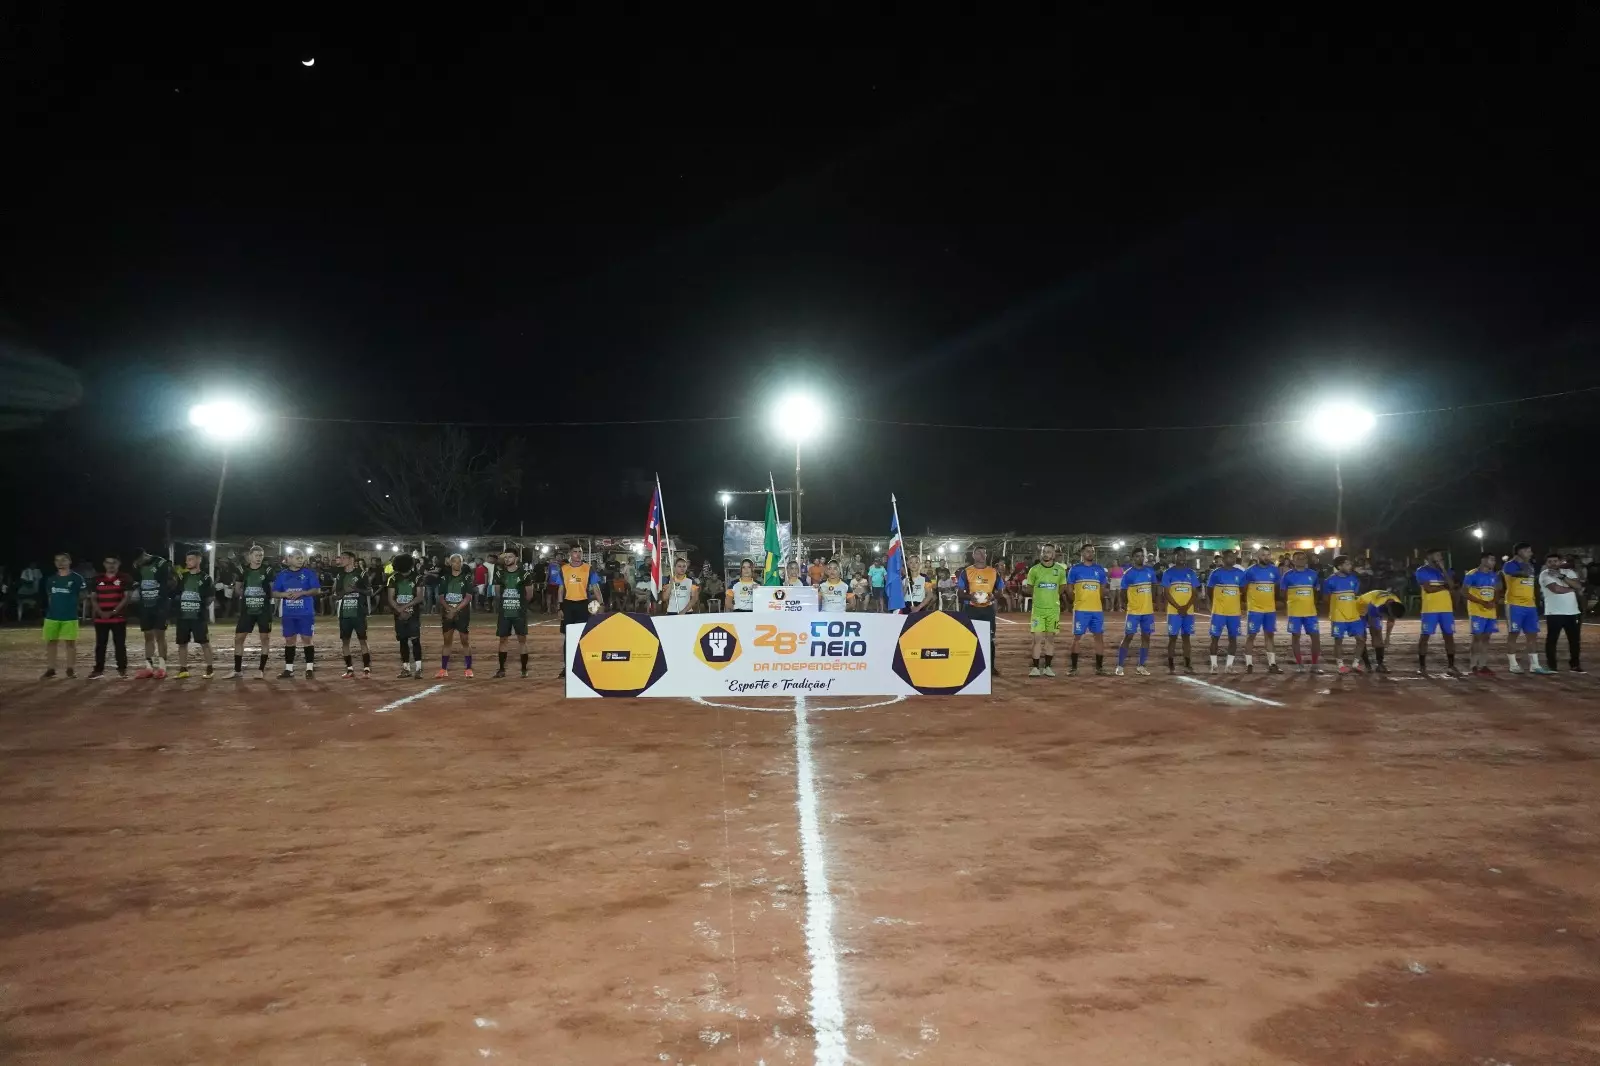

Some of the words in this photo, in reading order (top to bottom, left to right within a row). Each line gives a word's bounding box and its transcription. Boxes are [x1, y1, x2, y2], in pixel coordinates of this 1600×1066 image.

[753, 624, 809, 655] 28º
[810, 621, 862, 638] TOR
[810, 640, 867, 657] NEIO
[753, 662, 770, 672] DA
[772, 659, 868, 672] INDEPENDÊNCIA
